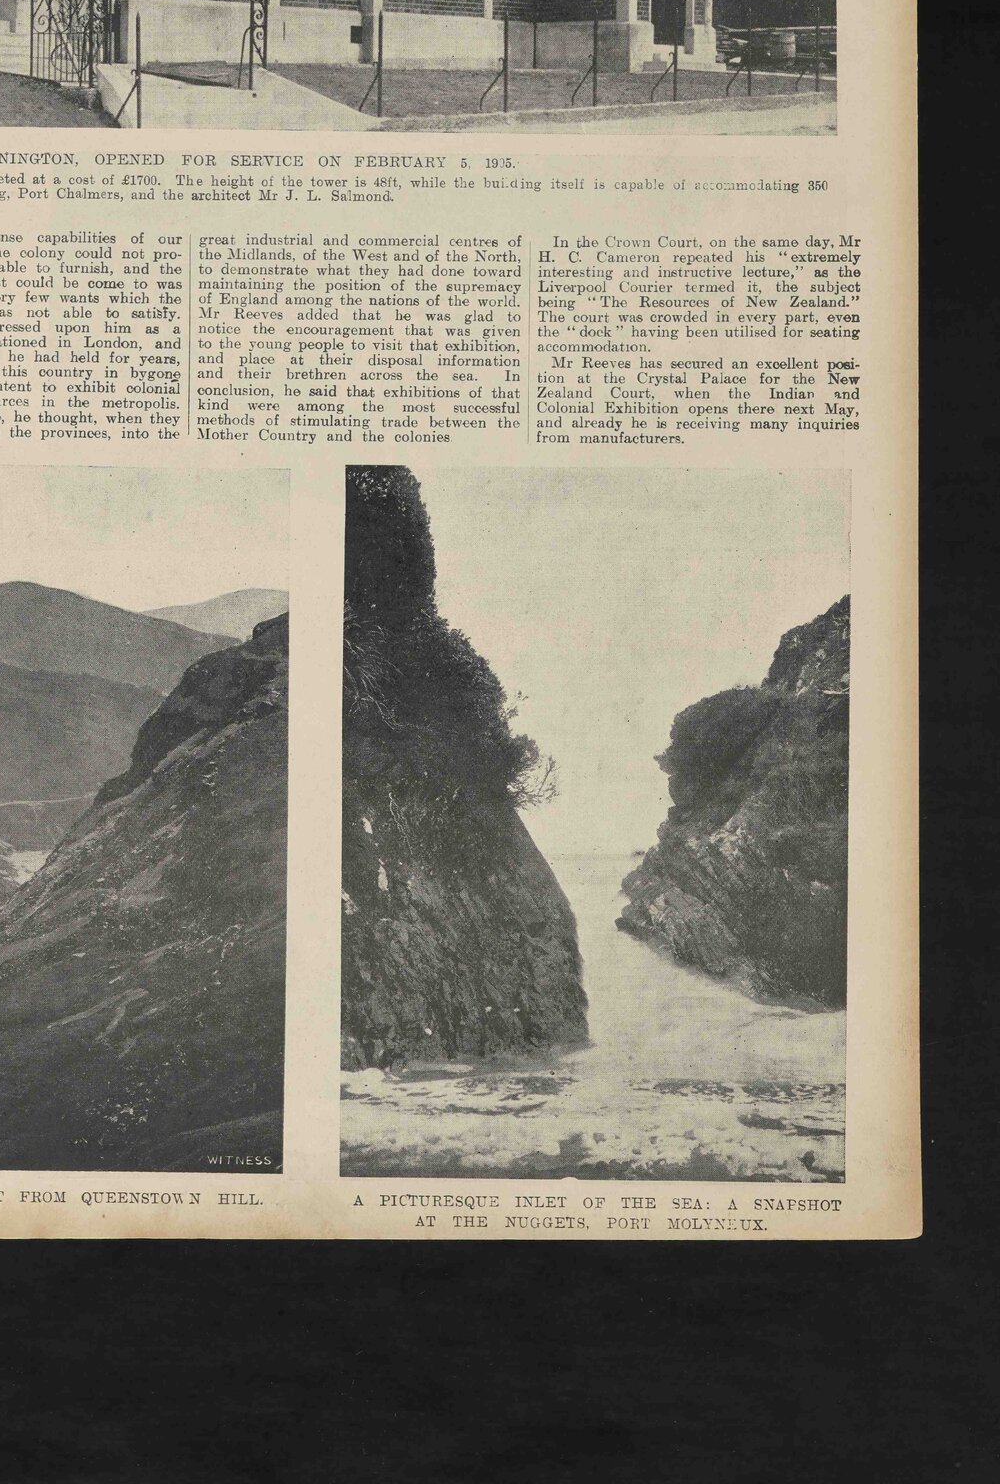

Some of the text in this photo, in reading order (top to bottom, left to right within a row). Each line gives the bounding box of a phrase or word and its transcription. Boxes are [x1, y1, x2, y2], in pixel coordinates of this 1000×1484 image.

[94, 152, 165, 166] OPENED
[181, 154, 217, 167] FOR
[230, 154, 304, 168] SERVICE
[318, 155, 342, 168] ON
[353, 154, 447, 169] FEBRUARY
[17, 186, 49, 200] Port
[56, 186, 124, 203] Chalmers,
[130, 187, 156, 201] and
[161, 188, 185, 201] the
[190, 188, 252, 202] architect
[257, 188, 279, 202] Mr
[285, 188, 299, 202] J.
[306, 189, 322, 202] L.
[330, 189, 395, 203] Salmond.
[36, 230, 117, 247] capabilities
[130, 231, 145, 245] of
[157, 235, 183, 246] our
[198, 232, 523, 249] great industrial and commercial centres of
[40, 394, 56, 408] in
[67, 394, 91, 409] the
[101, 396, 180, 412] metropolis.
[536, 400, 860, 419] Colonial Exhibition opens there next May,
[196, 427, 249, 441] Mother
[258, 427, 317, 445] Country
[326, 428, 353, 443] and
[361, 429, 385, 443] the
[535, 430, 685, 445] from manufacturers.
[207, 1155, 272, 1165] WITNESS
[19, 1190, 67, 1204] FROM
[80, 1191, 201, 1207] QUEENSTOWN
[217, 1192, 264, 1206] HILL.
[352, 1194, 365, 1207] A
[379, 1193, 500, 1211] PICTURESQUE
[514, 1195, 568, 1209] INLET
[582, 1196, 606, 1210] OF
[620, 1196, 657, 1210] THE
[671, 1197, 710, 1211] SEA:
[727, 1198, 739, 1211] A
[414, 1214, 768, 1232] AT THE NUGGETS, PORT MOLYNEUX.
